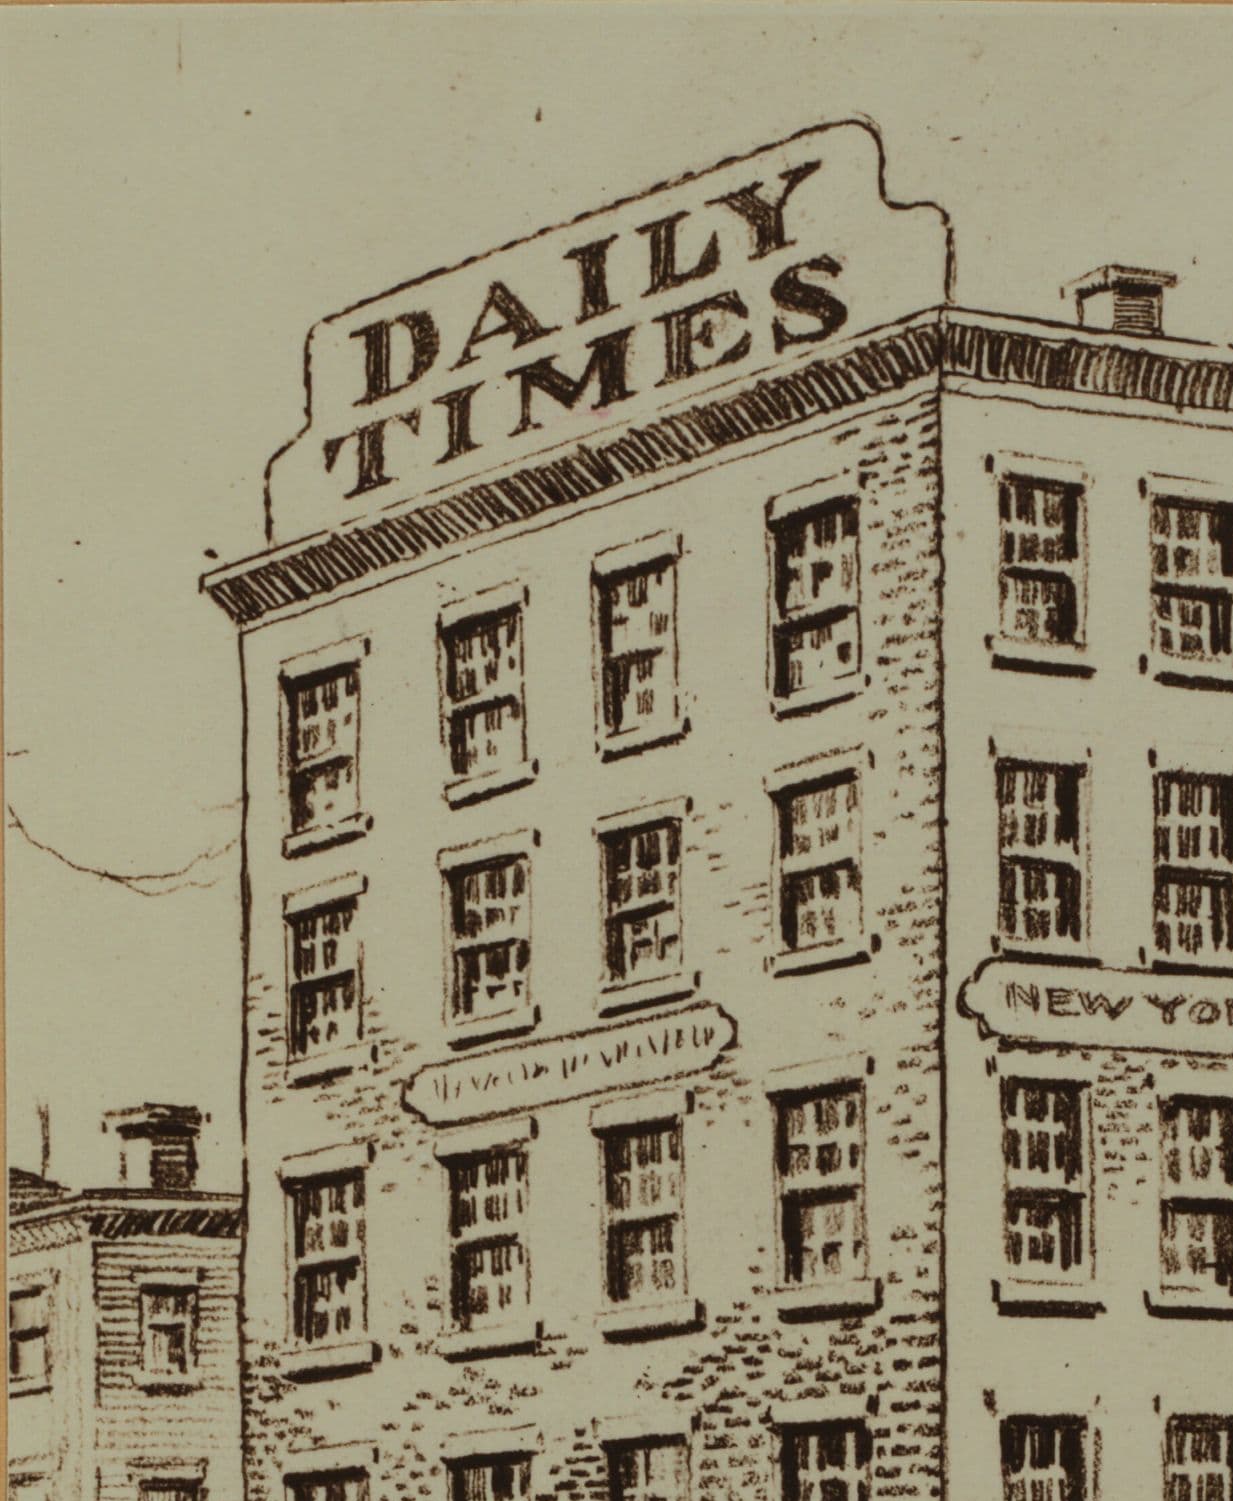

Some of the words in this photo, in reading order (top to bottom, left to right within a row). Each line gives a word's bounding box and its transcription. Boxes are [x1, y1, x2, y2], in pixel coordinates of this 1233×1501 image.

[323, 254, 848, 498] TIMES
[350, 159, 821, 405] DAILY
[1005, 982, 1132, 1021] NEW
